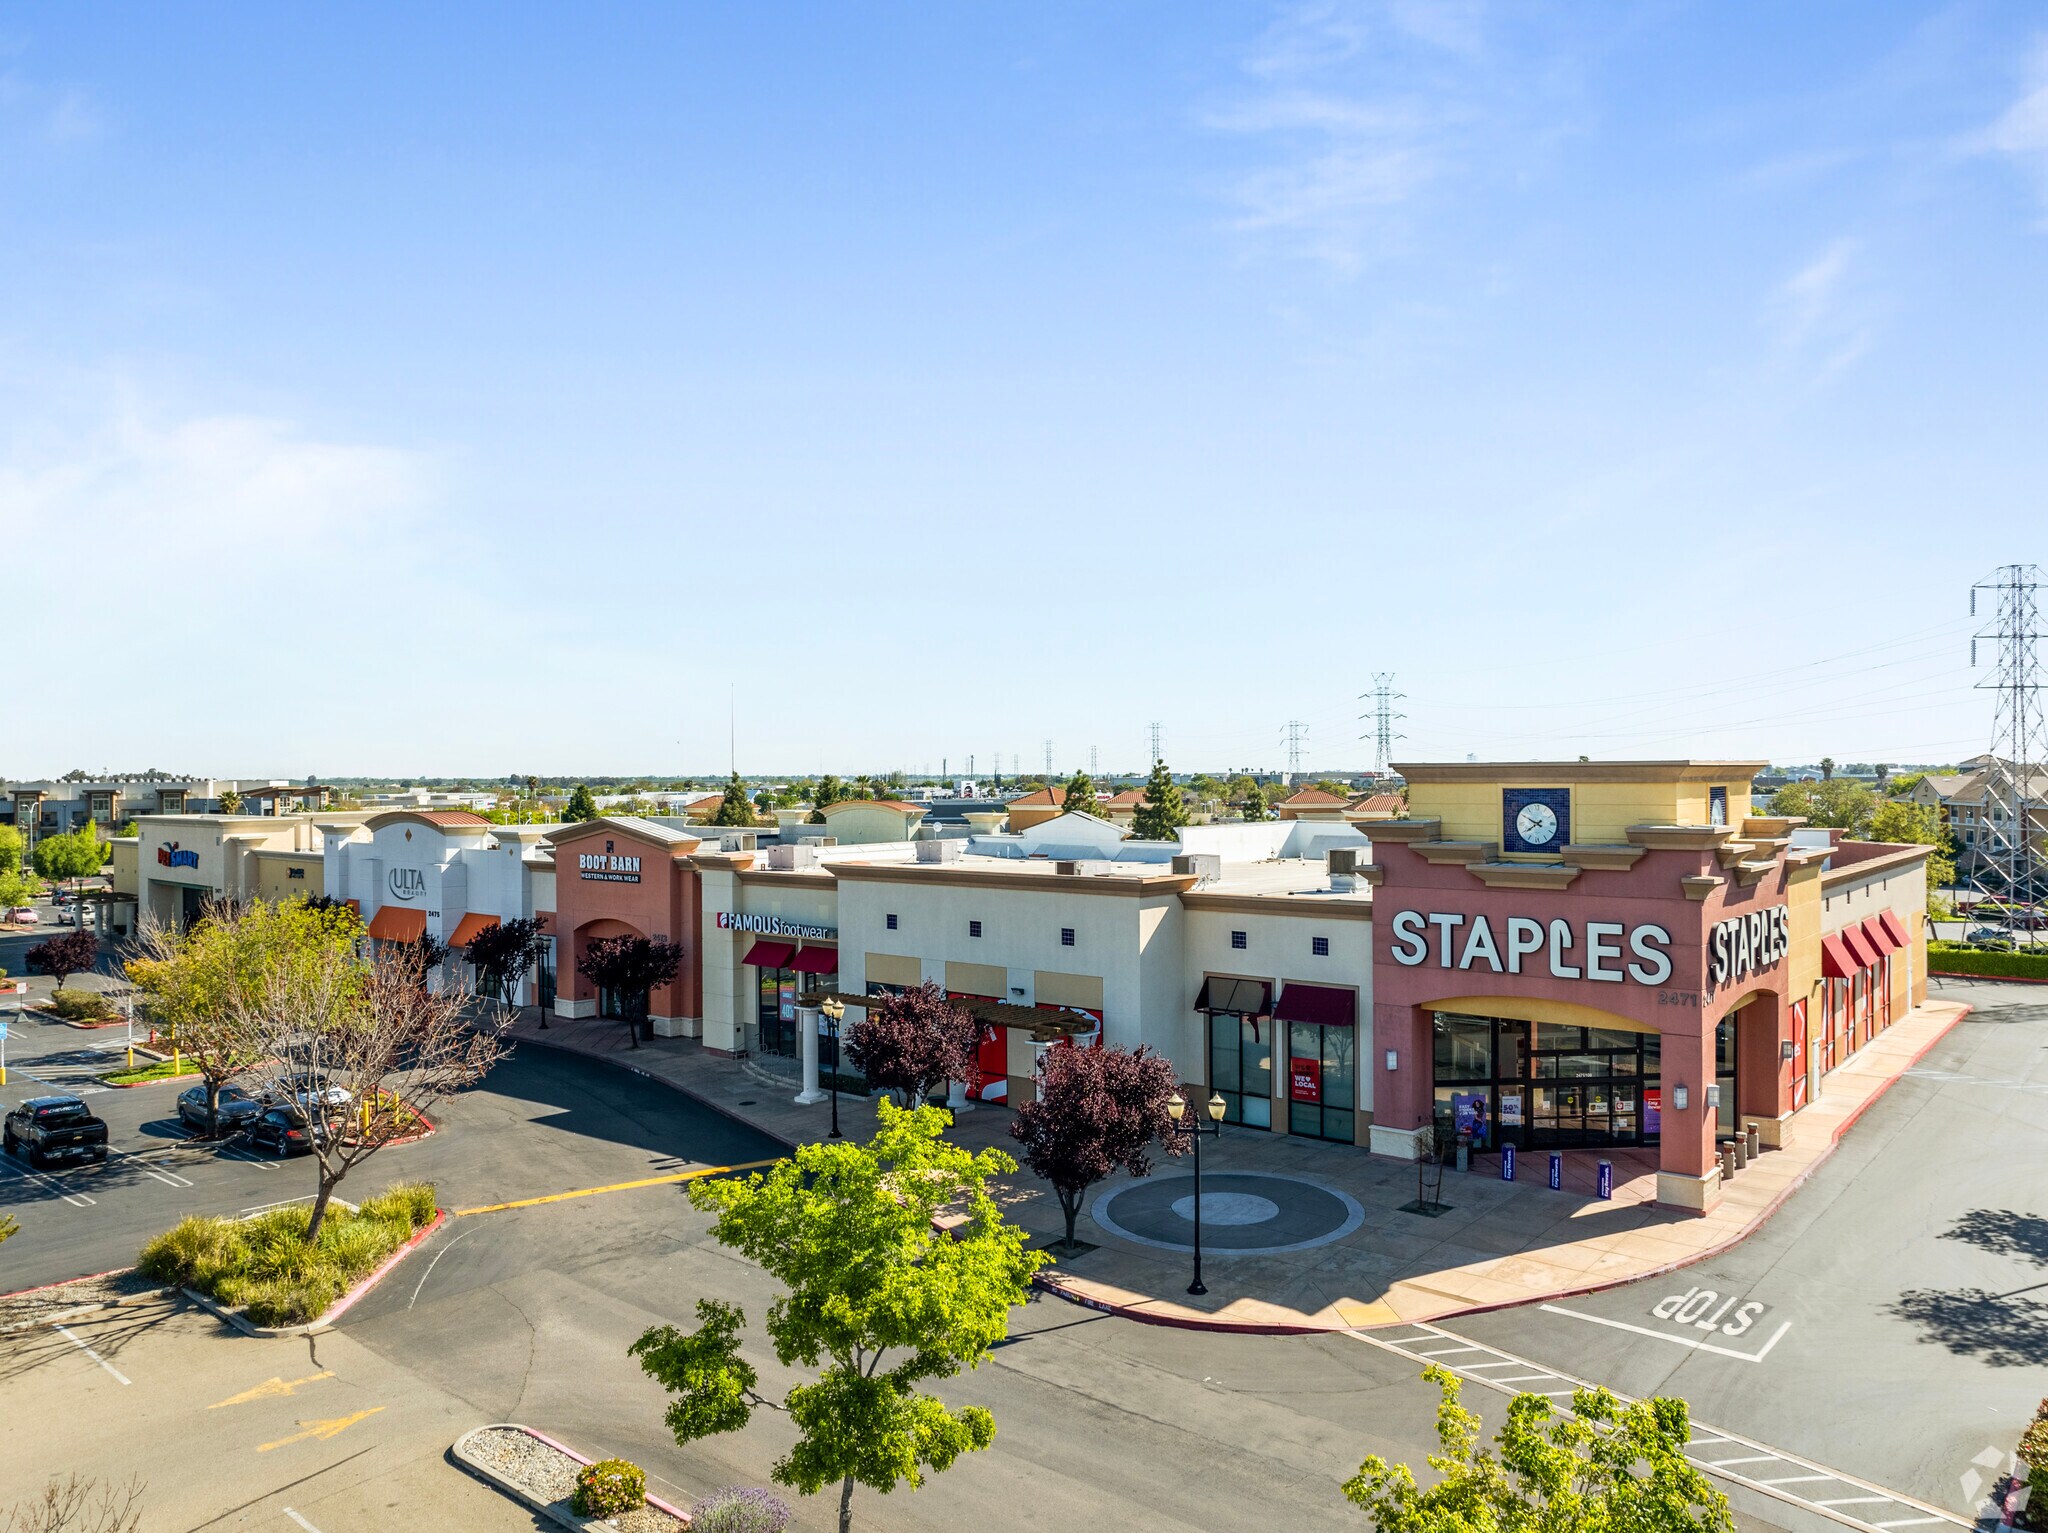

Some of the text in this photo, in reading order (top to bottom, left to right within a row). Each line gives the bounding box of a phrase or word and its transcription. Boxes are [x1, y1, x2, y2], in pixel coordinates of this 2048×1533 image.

[579, 854, 641, 872] BOOT BARN
[393, 868, 425, 891] ULTA
[581, 872, 603, 880] WESTERN
[428, 910, 440, 918] 2475
[729, 913, 828, 939] FAMOUS footwear
[1391, 909, 1672, 987] STAPLES
[1710, 904, 1789, 983] STAPLES
[1658, 990, 1698, 1008] 2471
[1295, 1081, 1316, 1089] LOCAL
[48, 1104, 83, 1114] CHEVROLET
[1652, 1286, 1764, 1336] STOP
